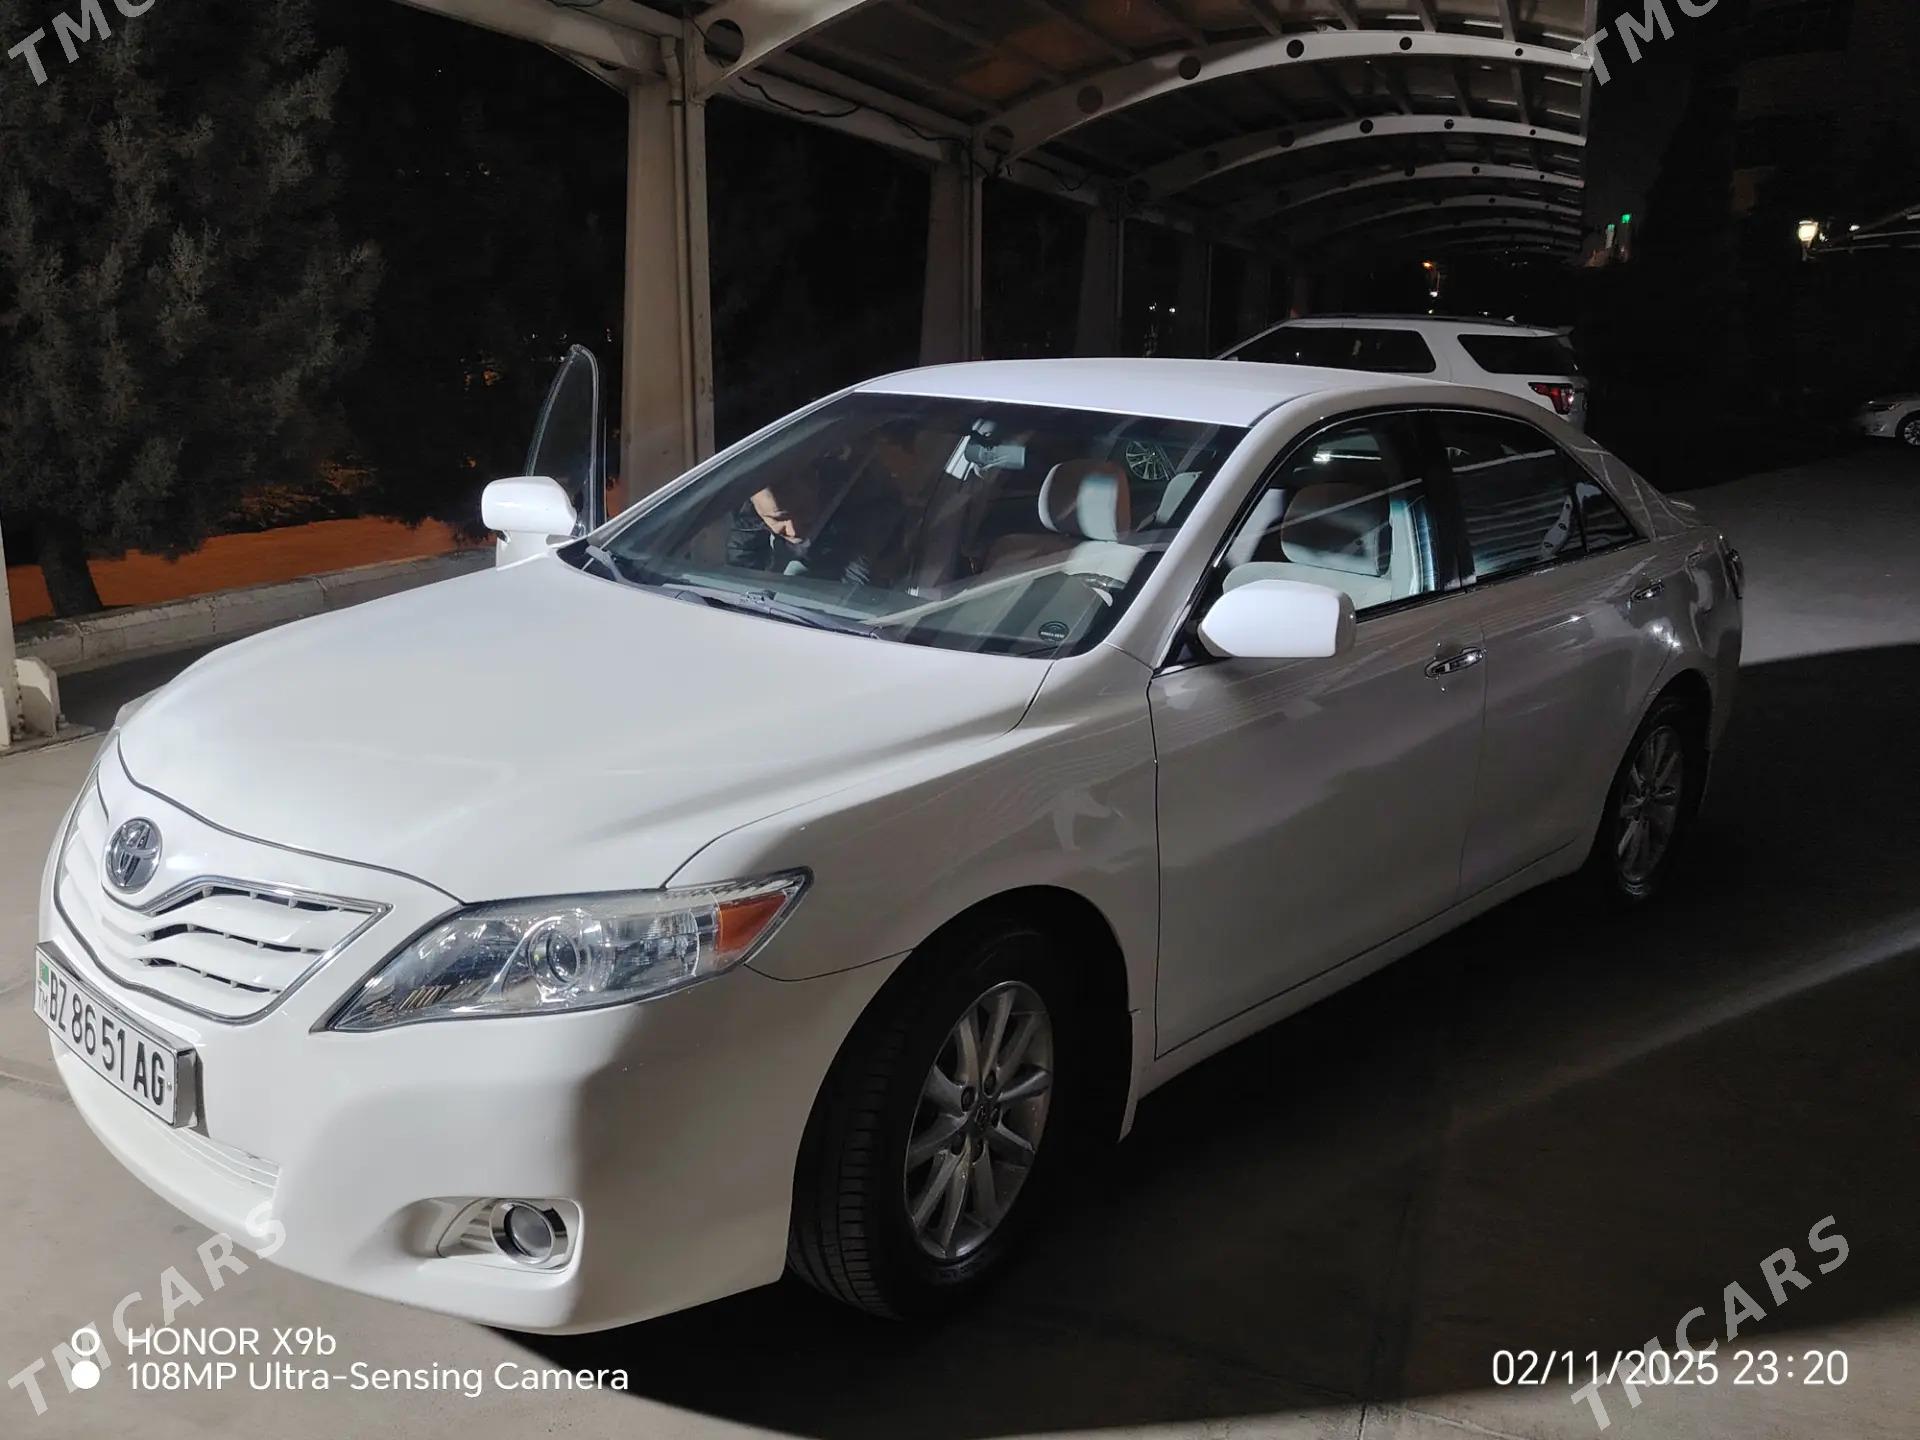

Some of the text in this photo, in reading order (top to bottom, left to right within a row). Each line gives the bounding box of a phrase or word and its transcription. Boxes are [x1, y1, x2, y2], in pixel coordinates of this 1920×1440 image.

[49, 969, 166, 1107] BZ 86 51 AG
